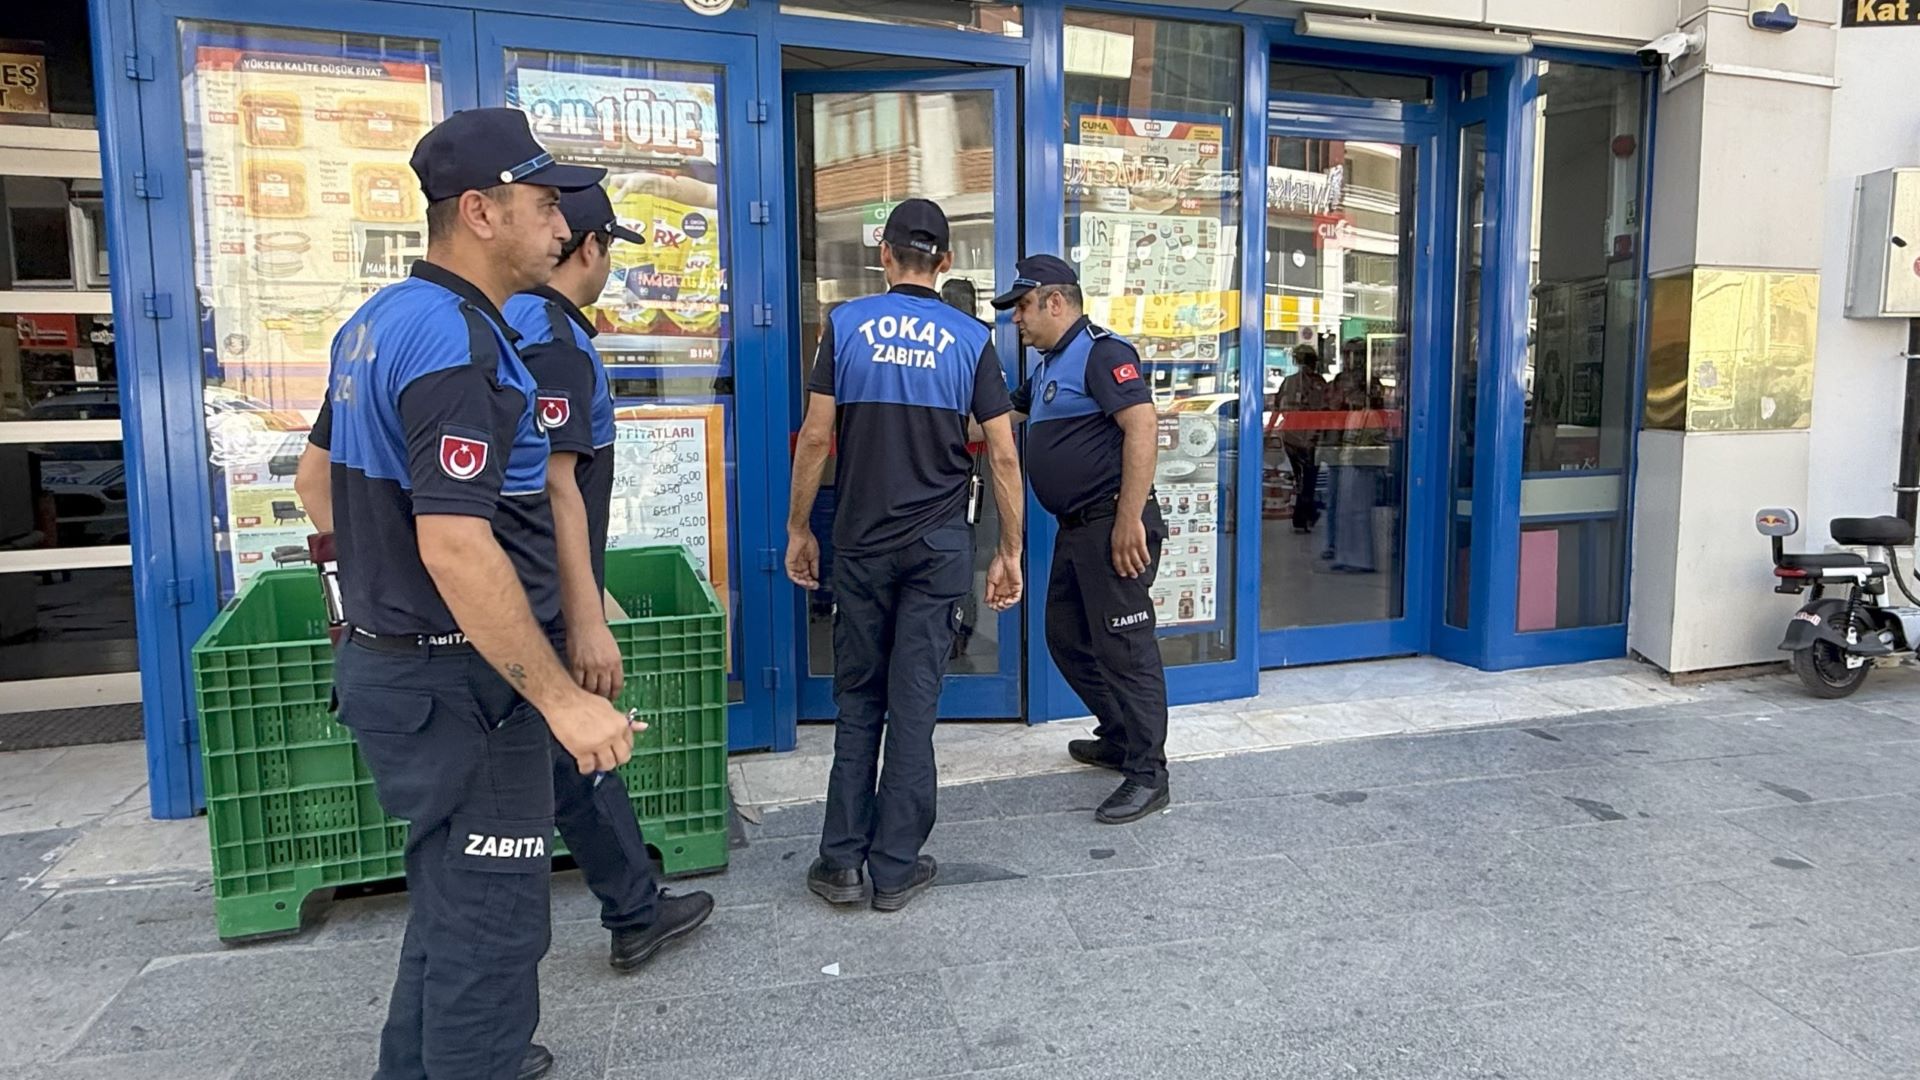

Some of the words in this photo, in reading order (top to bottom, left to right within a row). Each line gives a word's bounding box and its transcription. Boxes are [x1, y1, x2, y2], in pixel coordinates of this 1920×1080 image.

[1856, 0, 1909, 22] Kat
[244, 59, 282, 71] YÜKSEK
[285, 61, 319, 73] KALİTE
[321, 64, 354, 76] DÜŞÜK
[356, 66, 382, 77] FİYAT
[534, 100, 554, 132] 2
[560, 101, 593, 135] AL
[596, 98, 616, 142] 1
[624, 89, 699, 150] ÖDE
[1081, 121, 1108, 130] CUMA
[859, 315, 955, 354] TOKAT
[872, 344, 936, 369] ZABITA
[1111, 610, 1149, 627] ZABITA
[464, 833, 545, 858] ZABITA
